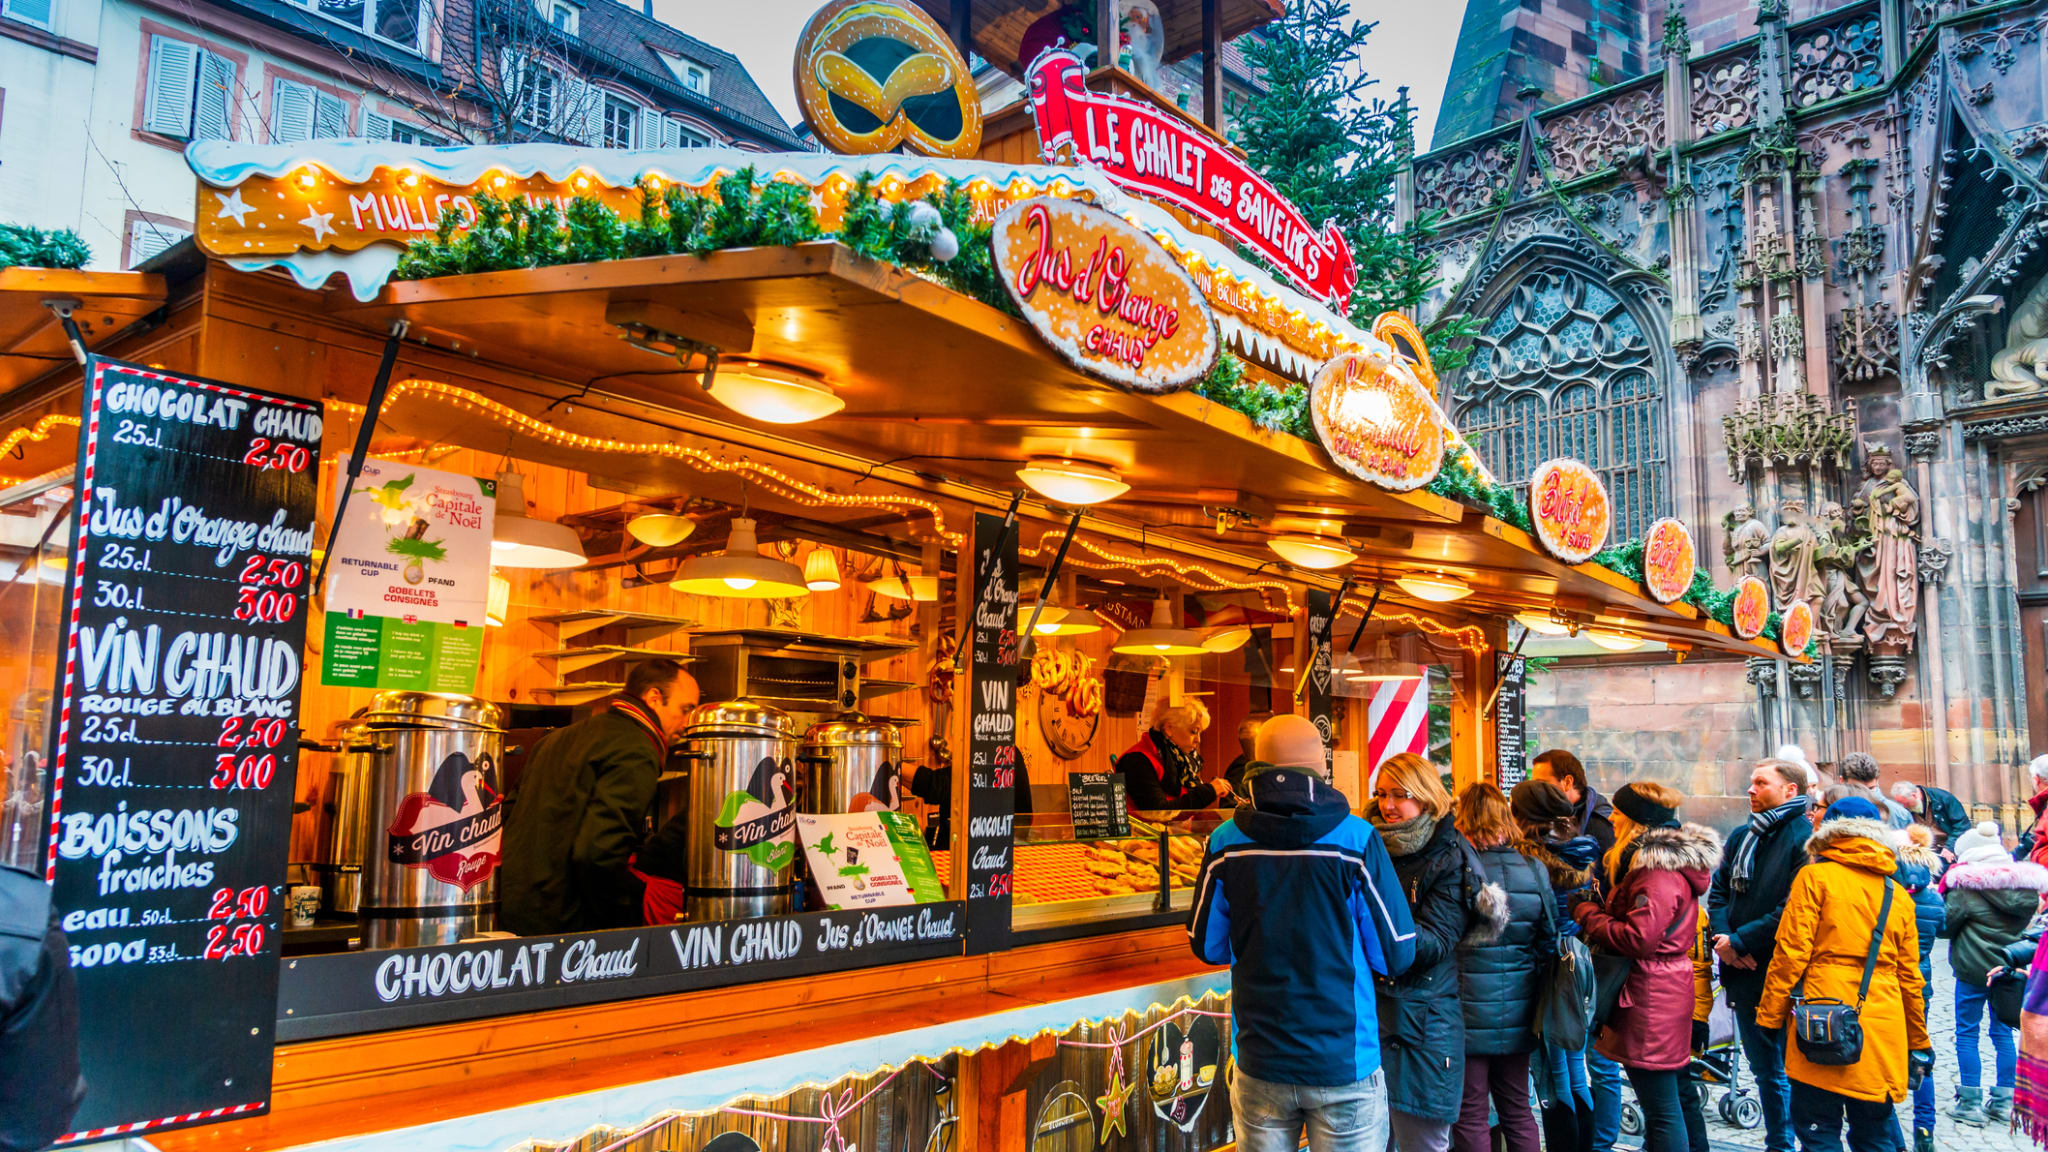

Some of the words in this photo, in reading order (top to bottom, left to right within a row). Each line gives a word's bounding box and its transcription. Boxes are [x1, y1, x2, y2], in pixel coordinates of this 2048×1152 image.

[1086, 107, 1125, 167] LE
[1131, 117, 1206, 194] CHALET
[1210, 175, 1232, 206] DES
[1236, 181, 1321, 281] SAVEURS
[1017, 203, 1077, 297] Jus
[1073, 235, 1180, 348] d'Orange
[1195, 272, 1211, 293] VIN
[1086, 324, 1145, 369] CHAUD
[106, 381, 249, 431] CHOCOLAT
[253, 406, 322, 442] CHAUD
[426, 493, 482, 515] Capitale
[90, 487, 146, 537] Jus
[145, 496, 258, 567] d'Orange
[449, 511, 481, 529] Noël
[341, 557, 399, 571] RETURNABLE
[360, 568, 380, 578] CUP
[388, 585, 436, 598] GOBELETS
[428, 577, 455, 587] PFAND
[976, 601, 1007, 629] Chaud
[163, 631, 298, 699] CHAUD
[79, 695, 177, 716] ROUGE
[212, 698, 292, 717] BLANC
[981, 680, 1009, 711] VIN
[974, 713, 1014, 733] CHAUD
[734, 822, 767, 844] Vin
[846, 829, 883, 842] Capitale
[970, 815, 1014, 838] CHOCOLAT
[412, 830, 454, 856] Vin
[456, 855, 487, 880] Rouge
[972, 845, 1008, 870] Chaud
[62, 907, 130, 933] eau
[375, 942, 555, 1002] CHOCOLAT
[561, 937, 640, 983] Chaud
[670, 923, 721, 969] VIN
[729, 919, 801, 966] CHAUD
[817, 918, 849, 952] Jus
[916, 907, 956, 940] Chaud
